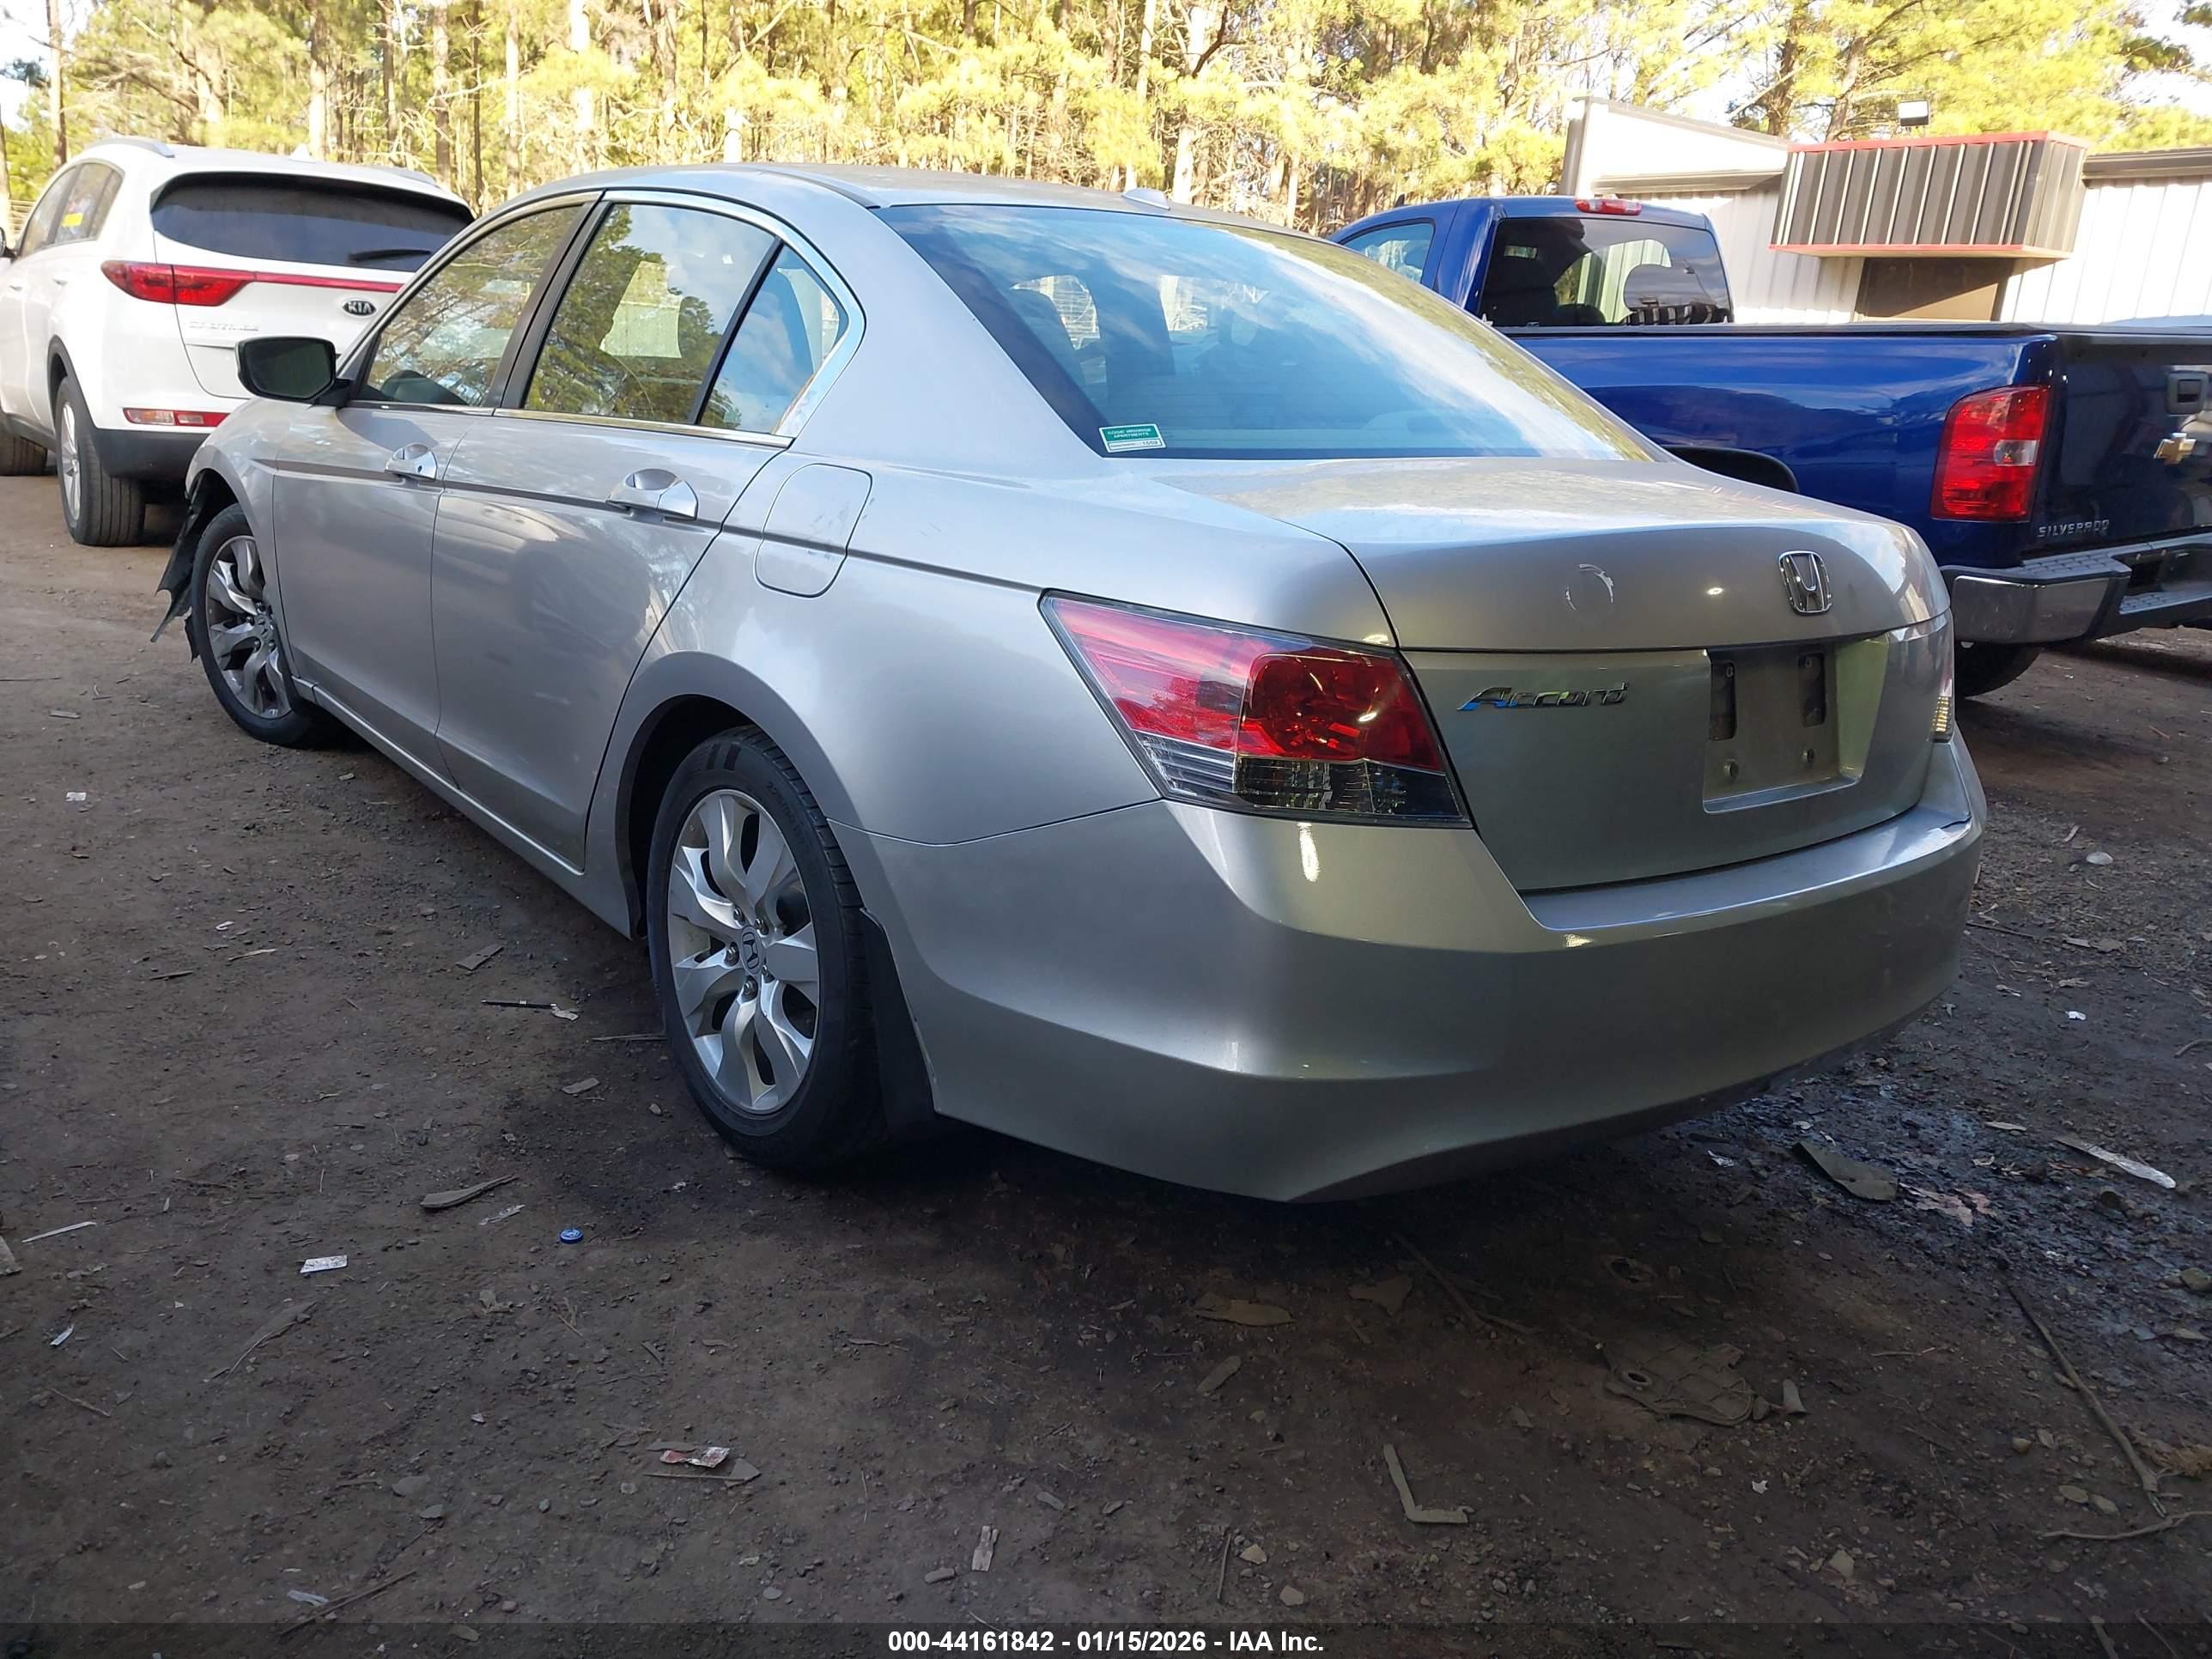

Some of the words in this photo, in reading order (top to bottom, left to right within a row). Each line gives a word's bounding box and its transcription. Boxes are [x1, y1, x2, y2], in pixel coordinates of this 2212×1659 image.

[347, 301, 374, 314] KIA
[2036, 520, 2110, 538] SILVERADO
[1456, 680, 1630, 711] Accord
